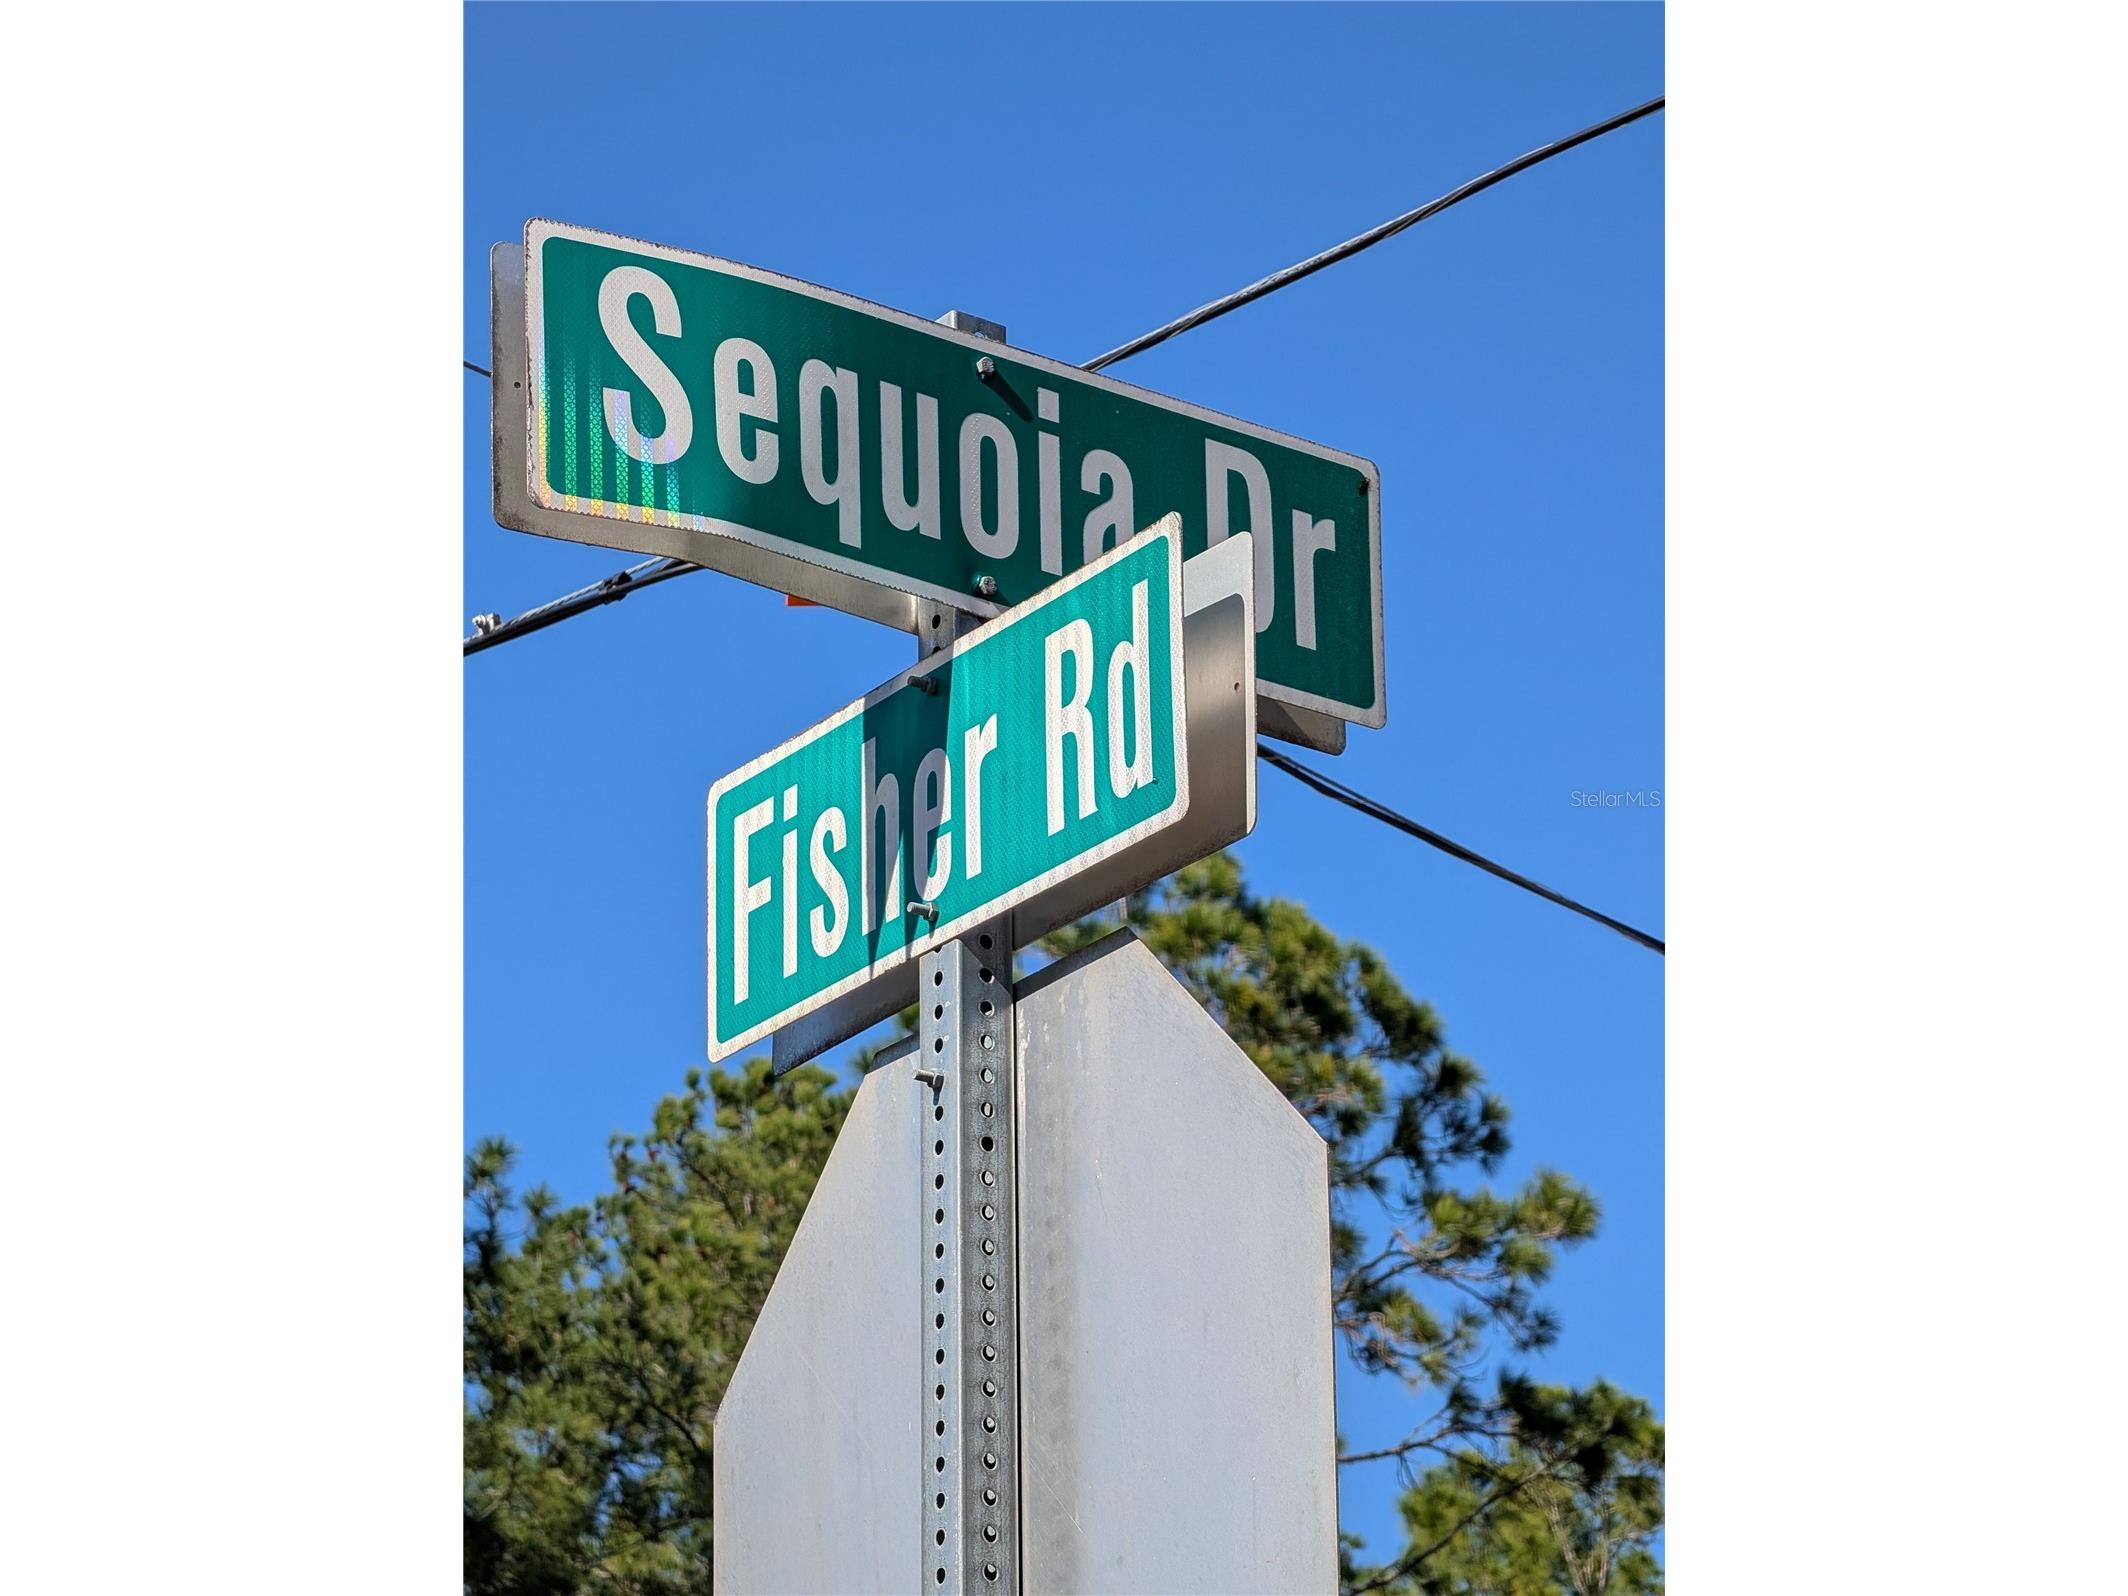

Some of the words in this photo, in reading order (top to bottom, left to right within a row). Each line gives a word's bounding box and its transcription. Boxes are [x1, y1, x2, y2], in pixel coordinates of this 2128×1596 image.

[598, 265, 1134, 576] Sequoia
[1204, 436, 1337, 652] Dr
[733, 713, 998, 1007] Fisher
[1044, 578, 1155, 838] Rd
